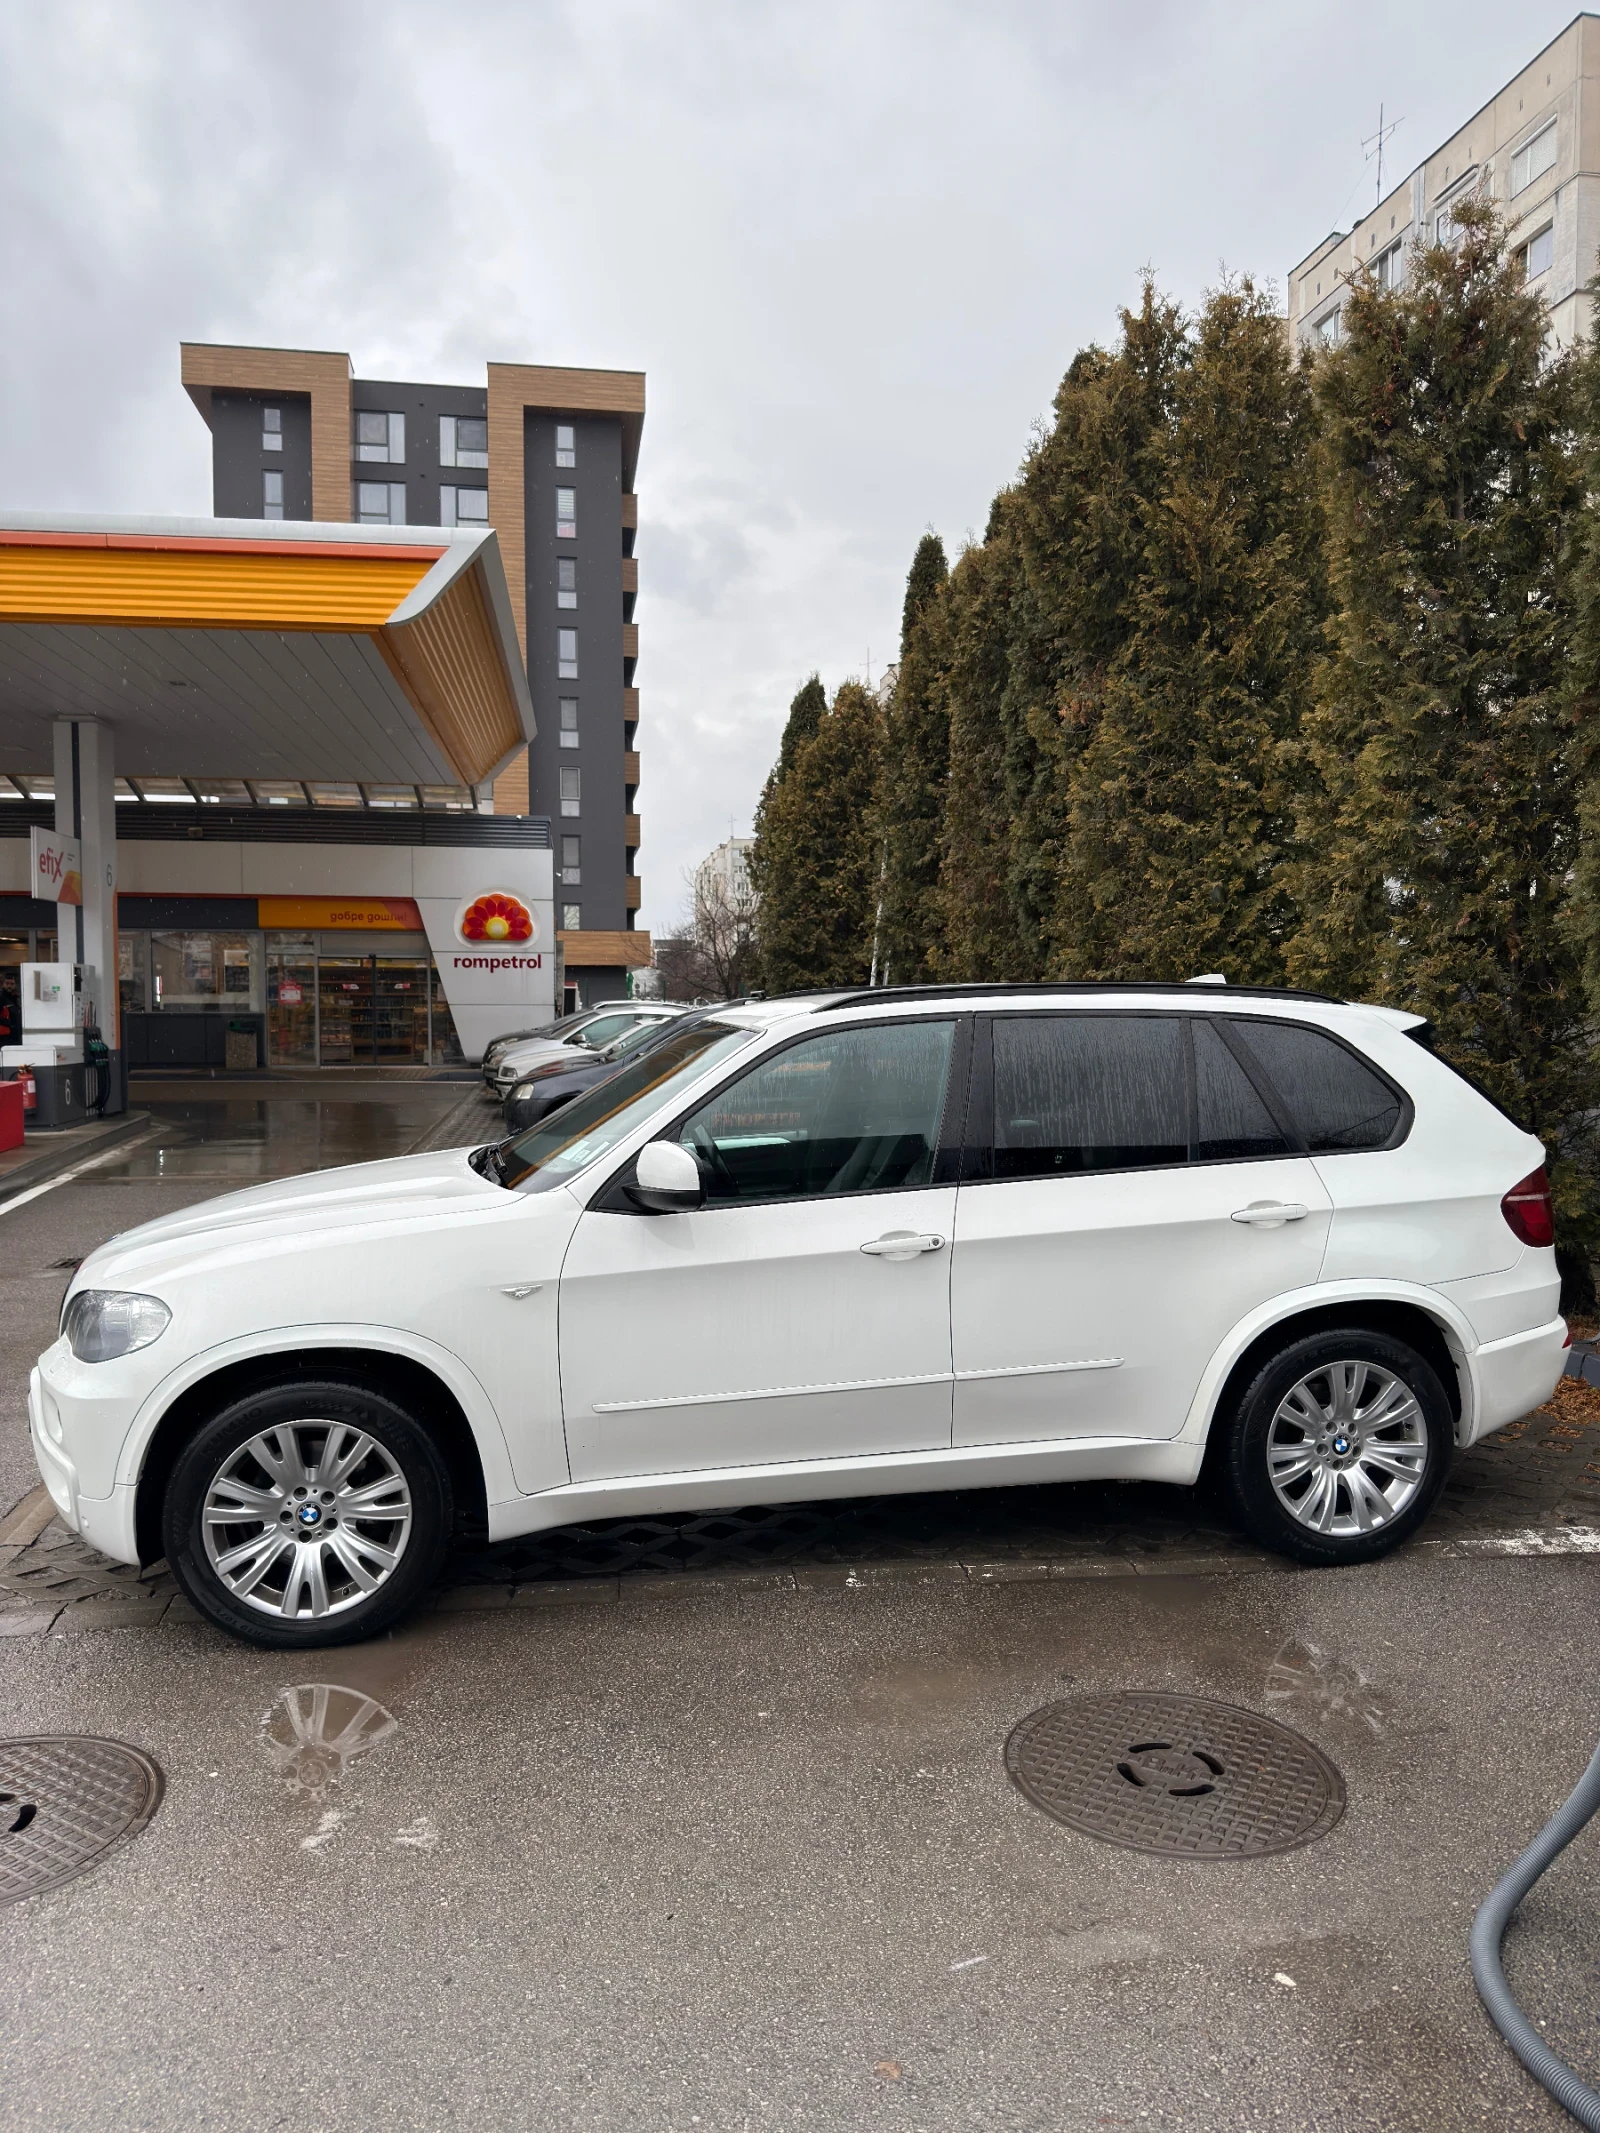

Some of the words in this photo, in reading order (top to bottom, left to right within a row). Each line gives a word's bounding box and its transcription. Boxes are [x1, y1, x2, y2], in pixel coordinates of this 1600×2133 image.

[40, 847, 64, 883] efix
[106, 864, 113, 887] 6
[330, 911, 364, 923] добре
[453, 953, 542, 973] rompetrol
[65, 1078, 71, 1105] 6
